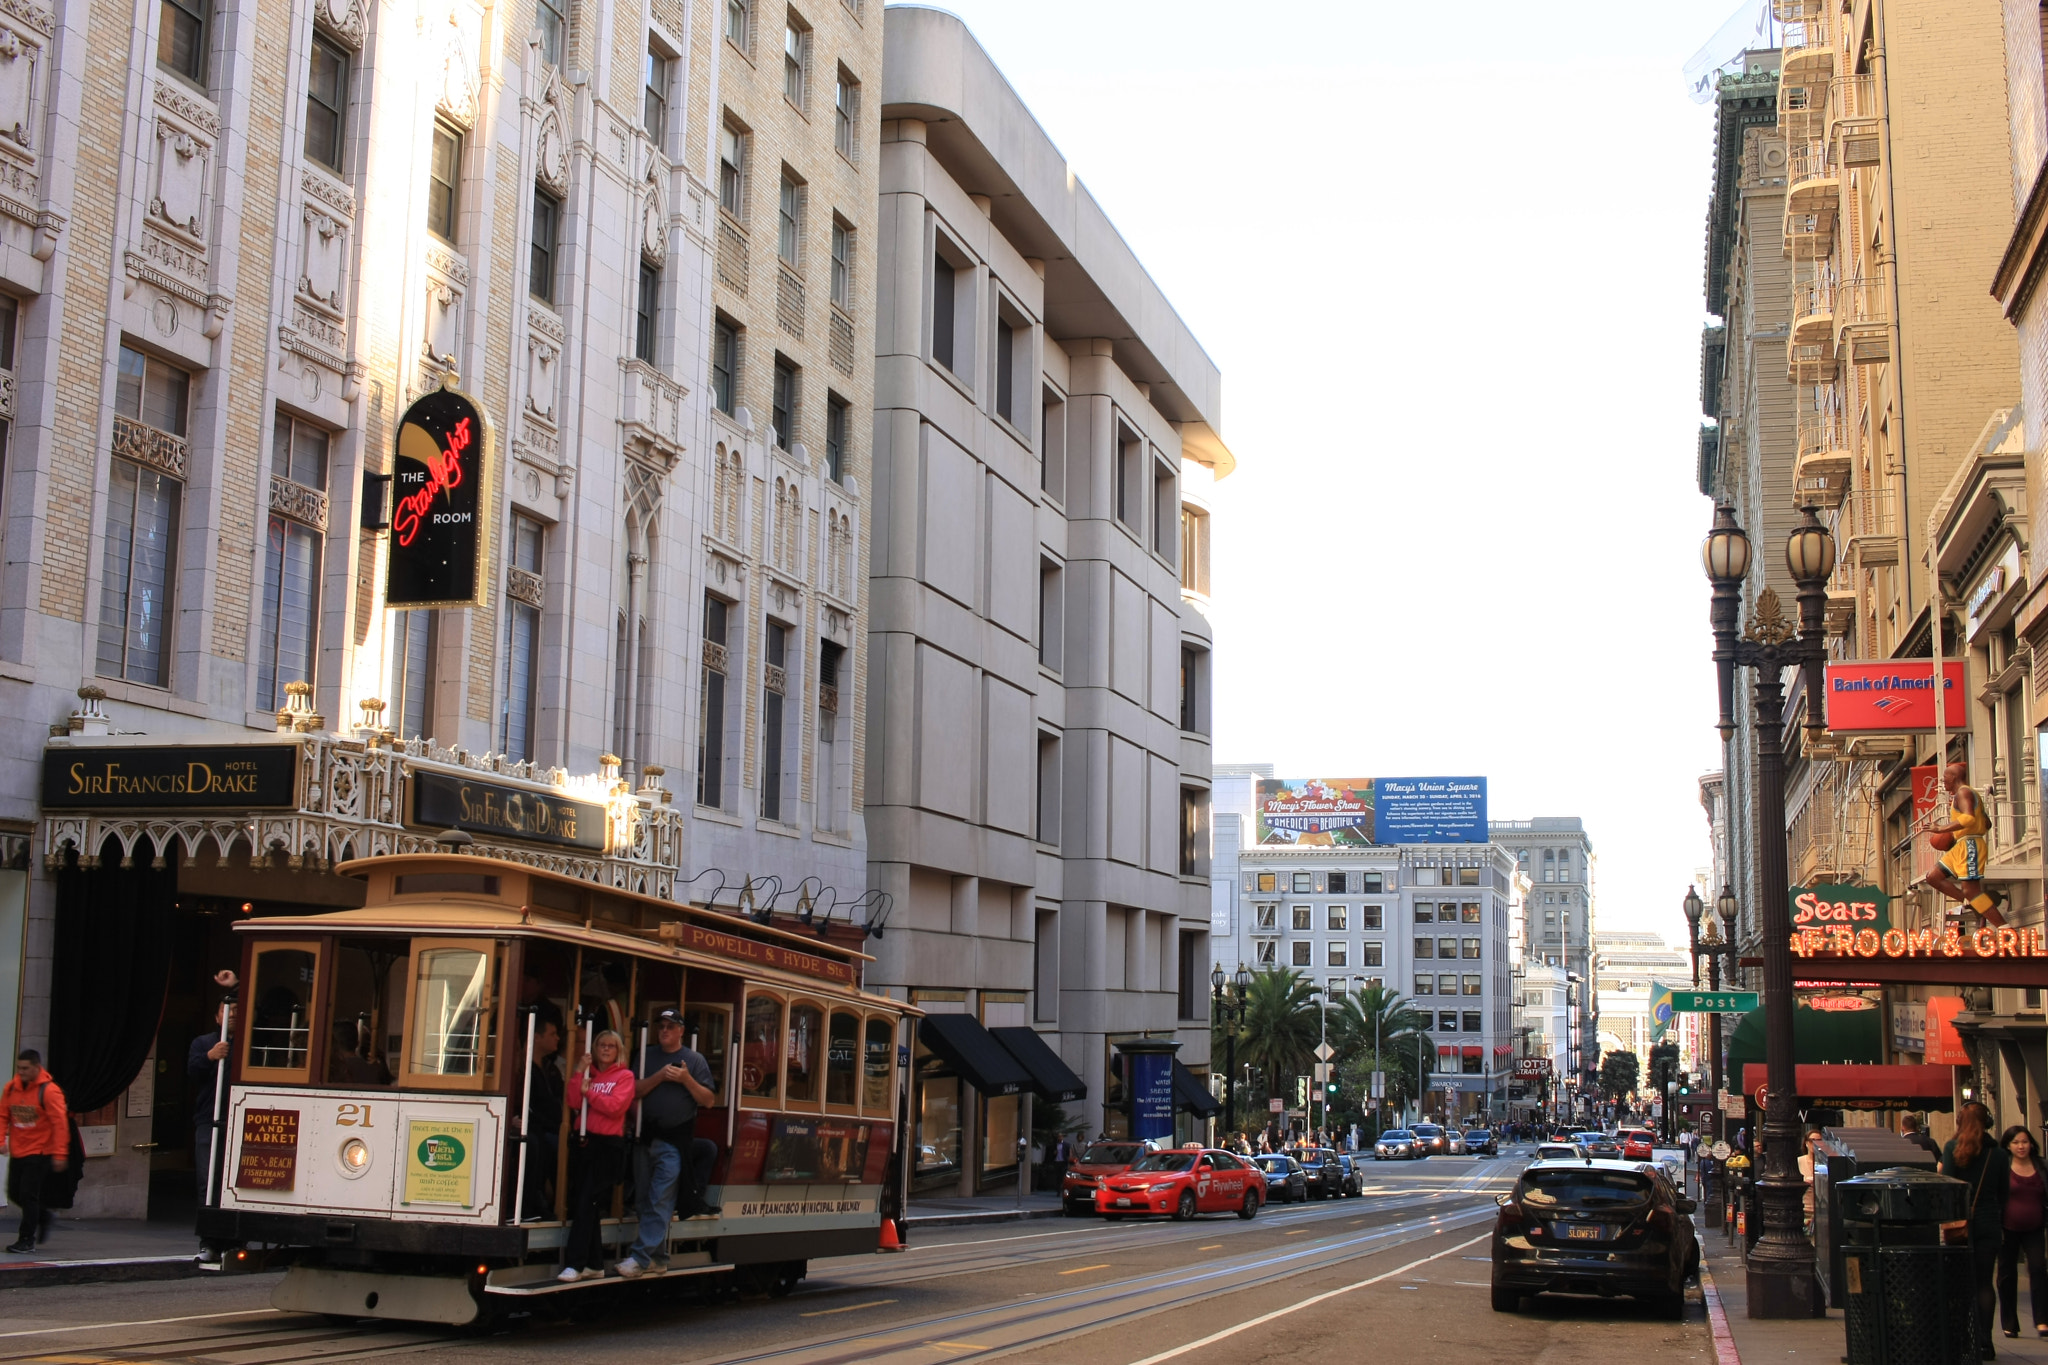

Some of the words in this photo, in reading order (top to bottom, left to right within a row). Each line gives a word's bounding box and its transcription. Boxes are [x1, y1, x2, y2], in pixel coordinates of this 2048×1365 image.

[394, 417, 471, 546] Starlight
[402, 472, 424, 484] THE
[433, 512, 472, 524] ROOM
[1833, 676, 1872, 692] Bank
[1873, 675, 1889, 690] of
[1890, 674, 1952, 690] Ameria
[225, 762, 258, 770] HOTEL
[1384, 783, 1416, 794] Macy's
[1418, 782, 1444, 792] Union
[1446, 782, 1478, 792] Square
[1268, 800, 1300, 812] Macy's
[1300, 800, 1333, 812] Flower
[1334, 800, 1361, 811] Show
[1274, 817, 1308, 830] AMERICA
[1320, 817, 1354, 830] BEAUTIFUL
[1793, 892, 1877, 923] Sears
[1790, 930, 1824, 958] AP
[1836, 928, 1933, 958] ROOM
[1943, 928, 1964, 958] &
[692, 930, 758, 958] POWELL
[765, 948, 775, 961] &
[784, 952, 820, 972] HYDE
[826, 962, 846, 978] Sts.
[1694, 997, 1736, 1007] Post
[1812, 998, 1862, 1008] Dinner
[1812, 1099, 1846, 1107] Sears
[246, 1114, 296, 1126] POWELL
[336, 1103, 374, 1128] 21
[244, 1132, 296, 1144] MARKET
[241, 1156, 259, 1166] HYDE
[269, 1156, 292, 1168] BEACH
[244, 1168, 287, 1178] FISHERMANS
[1213, 1178, 1244, 1194] Flywheel
[742, 1203, 758, 1216] SAN
[760, 1202, 799, 1216] FRANCISCO
[801, 1202, 834, 1214] MUNICIPAL
